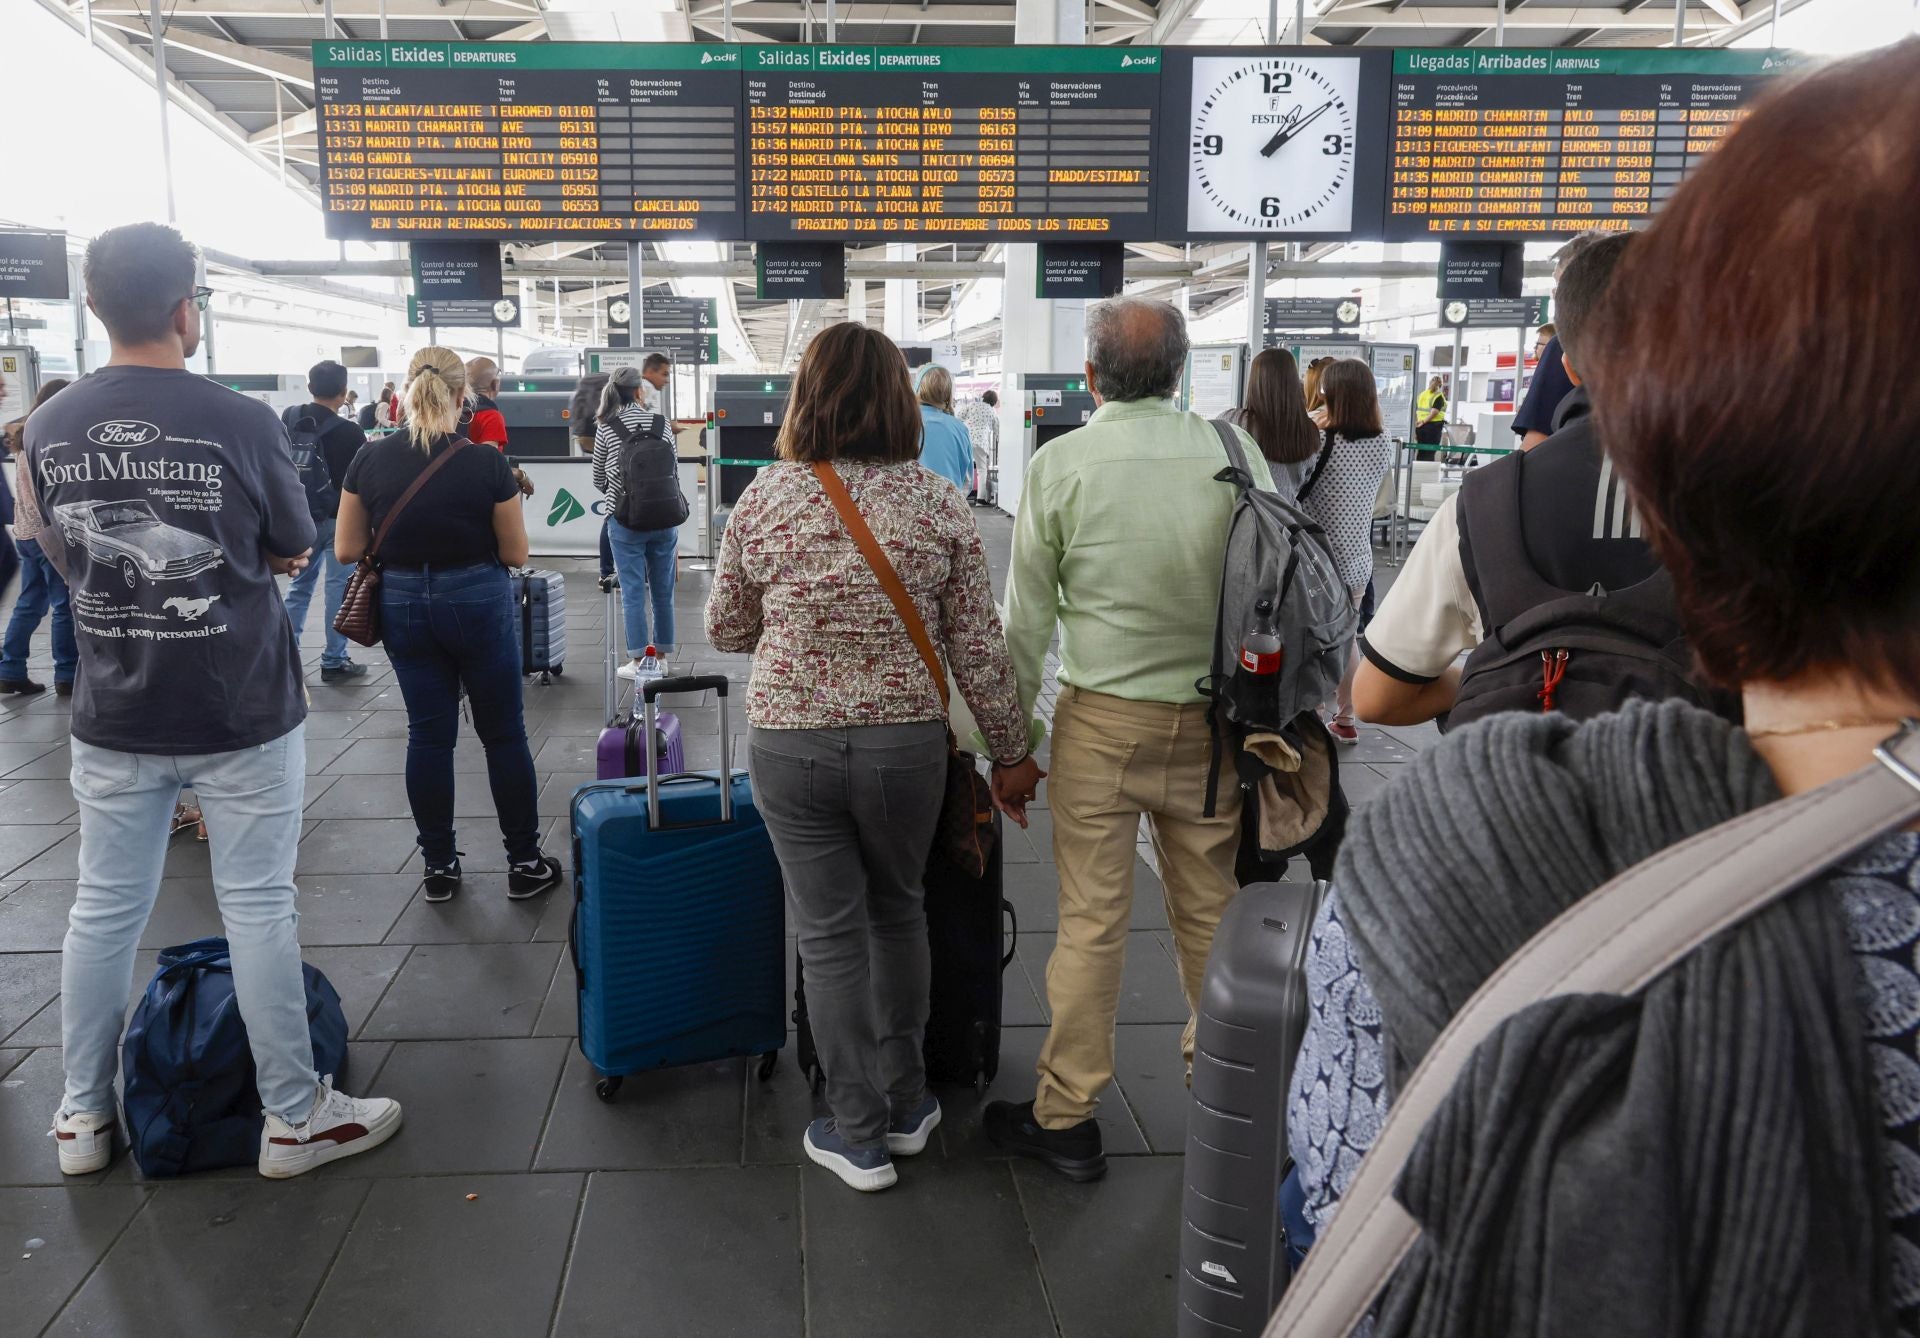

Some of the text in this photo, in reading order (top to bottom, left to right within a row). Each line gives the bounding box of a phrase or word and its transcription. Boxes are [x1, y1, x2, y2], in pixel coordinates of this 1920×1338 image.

[330, 47, 516, 62] Salidas Eixides DEPARTURES
[714, 52, 737, 61] adif
[759, 51, 940, 65] Salidas Eixides DEPARTURES
[1134, 56, 1156, 64] adif
[1410, 54, 1600, 71] Llegadas Arribades ARRIVALS
[1260, 73, 1291, 93] 12
[789, 90, 826, 98] Destinació
[324, 105, 596, 117] 13:23 ALACANT/ALICANTE EUROMED 01101
[751, 107, 1016, 119] 15:32 MADRID PTA. ATOCHA AVLO 05155
[1252, 115, 1297, 124] FESTINA
[751, 123, 1016, 135] 15:57 MADRID PTA. ATOCHA IRYO 06163
[326, 137, 597, 149] 13:57 MADRID PTA. ATOCHA IRYO 06143
[1203, 135, 1222, 155] 9
[1323, 135, 1342, 155] 3
[1396, 141, 1652, 152] 13:13 FIGUERES-VILAFANT EUROMED 01101
[327, 153, 597, 164] 14:40 GANDIA INTCITY 05910
[752, 154, 1015, 166] 16:59 BARCELONA SANTS INTCITY 00694
[752, 170, 1140, 182] 17:22 MADRID PTA. ATOCHA OUIGO 06573 IMADO/ESTIMAT
[330, 200, 699, 211] 15:27 MADRID PTA. ATOCHA OUIGO 06553 CANCELADO
[1260, 197, 1280, 217] 6
[397, 218, 442, 229] SUFRIR
[520, 219, 622, 229] MODIFICACIONES
[630, 219, 636, 229] Y
[643, 219, 693, 229] CAMBIOS
[883, 219, 1109, 230] 05 DE NOVIEMBRE TODOS LOS TRENES
[1429, 220, 1456, 230] ULTE
[1463, 220, 1470, 230] A
[1477, 220, 1490, 230] SU
[1497, 220, 1545, 230] EMPRESA
[417, 311, 425, 322] 5
[700, 313, 708, 324] 4
[1533, 312, 1539, 323] 2
[700, 349, 709, 361] 4
[100, 424, 148, 442] Ford
[41, 452, 222, 489] Ford Mustang
[193, 489, 201, 497] by
[93, 624, 228, 640] small, sporty personal car
